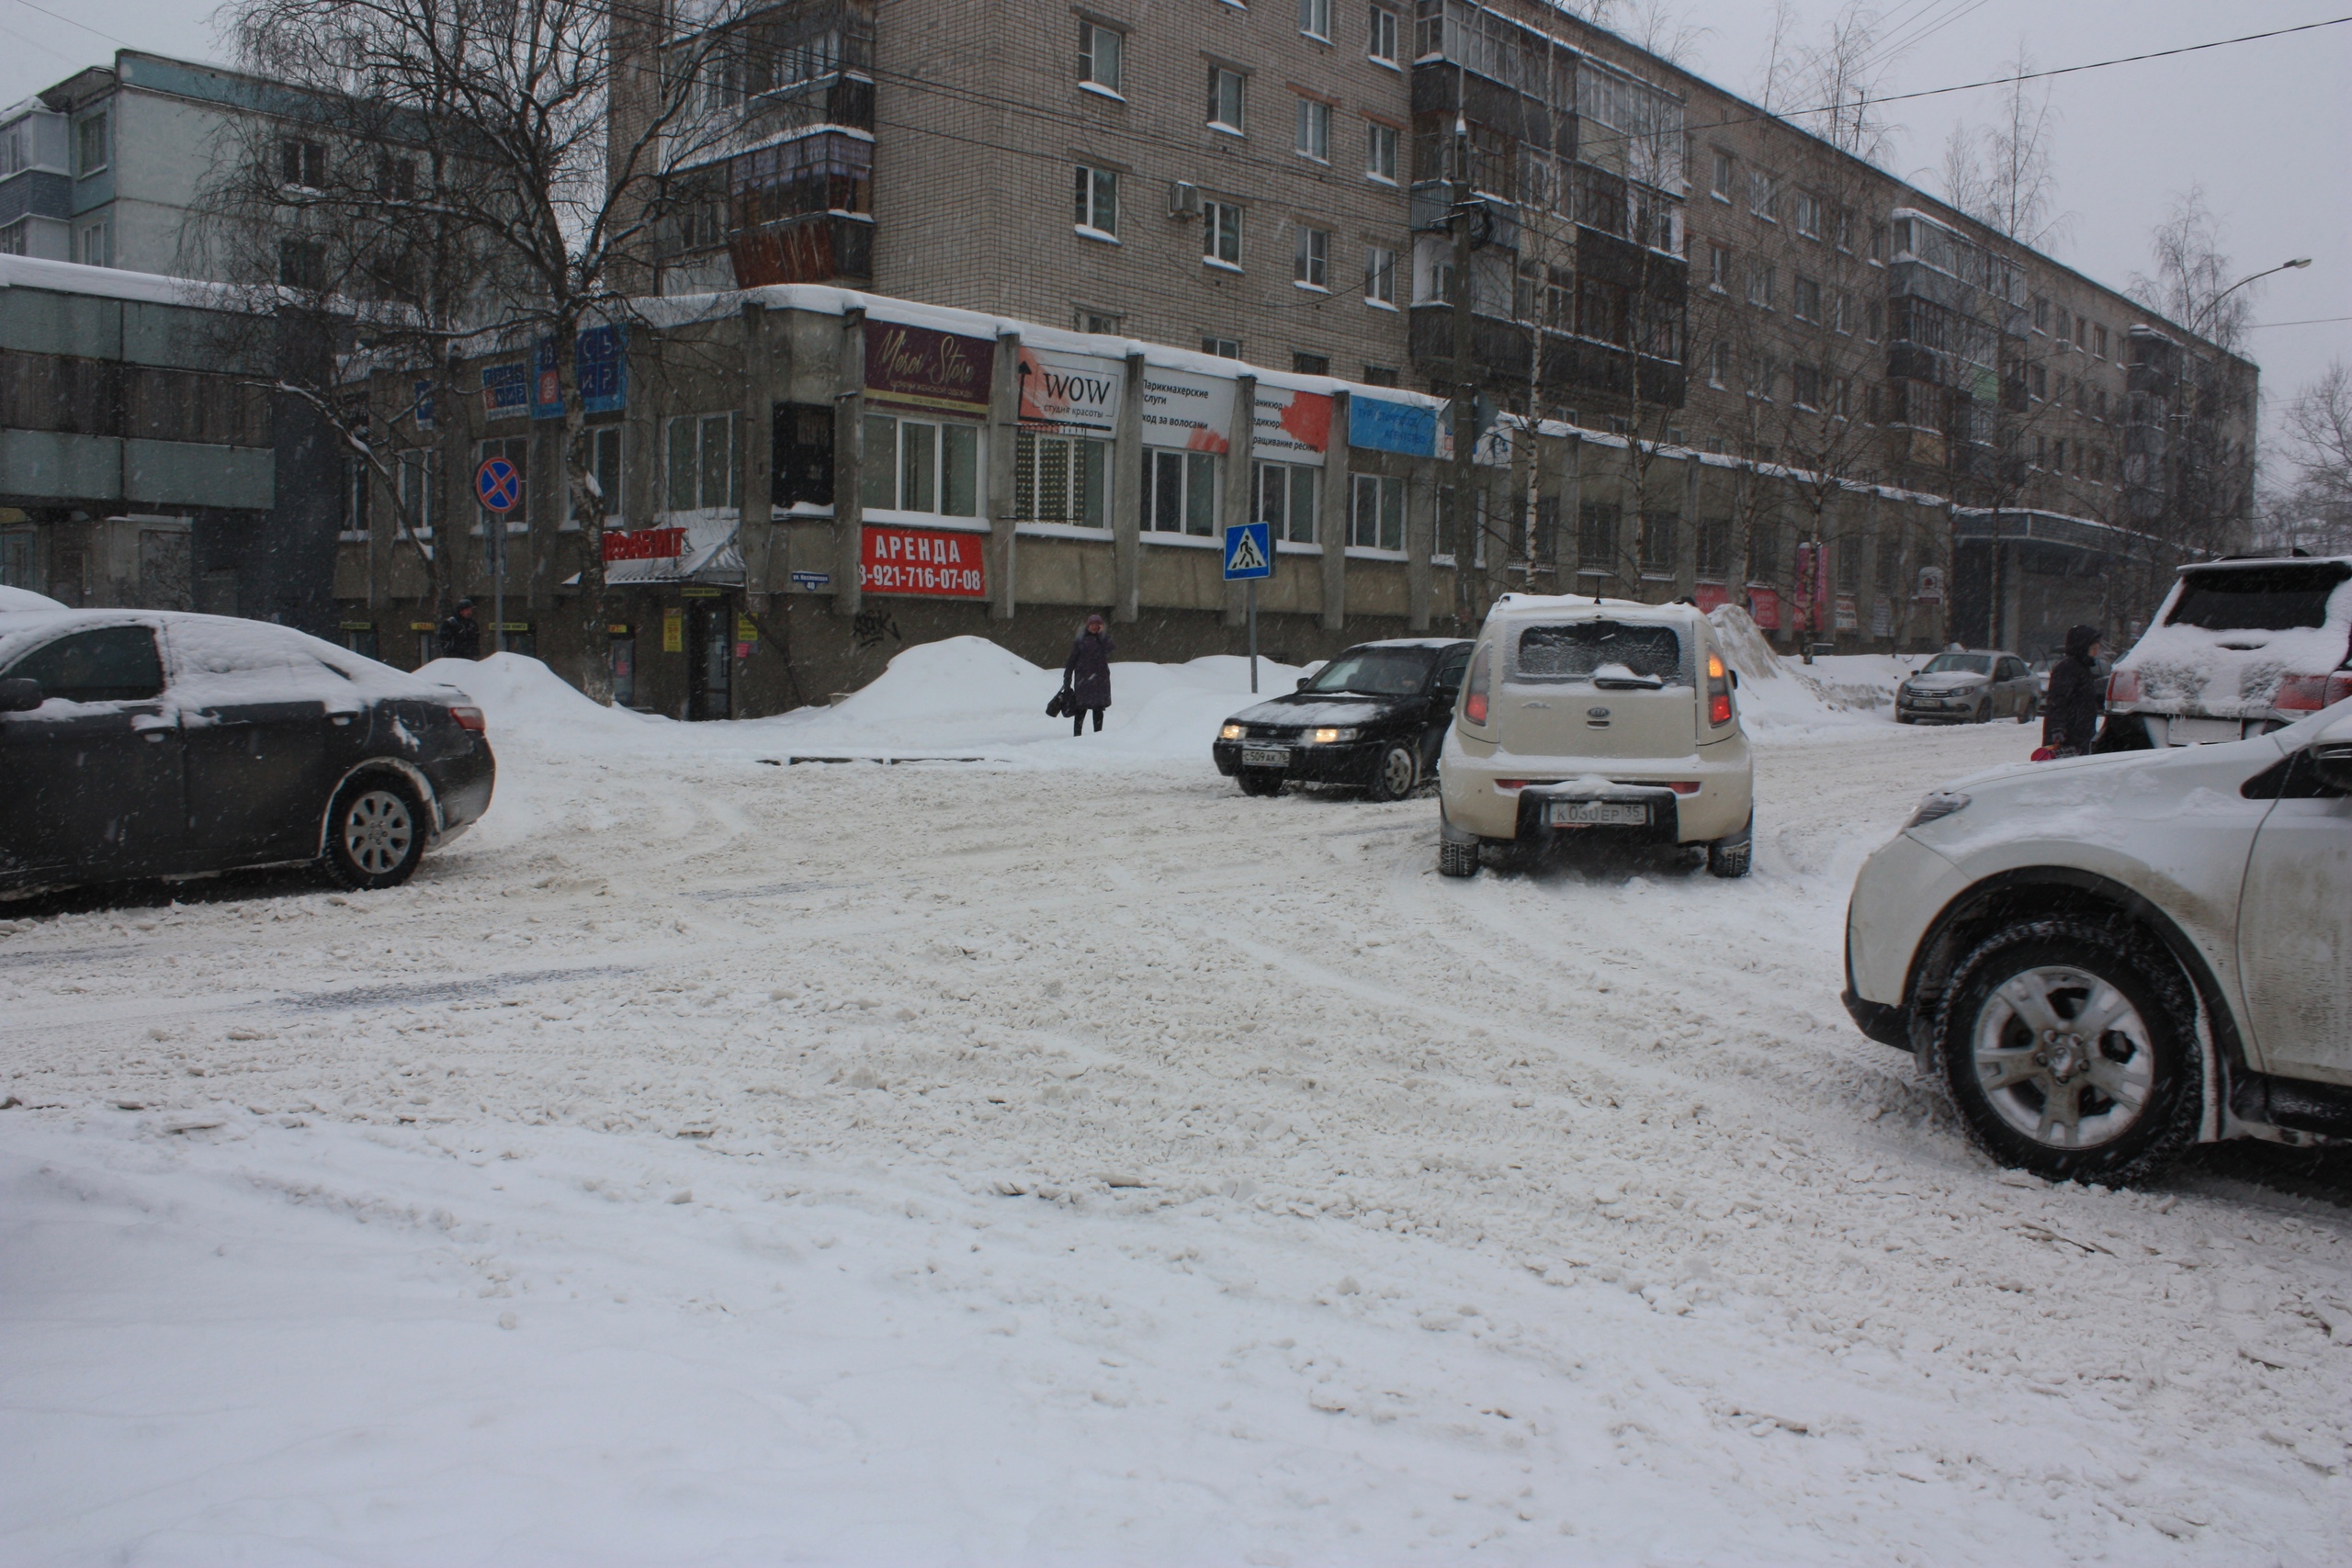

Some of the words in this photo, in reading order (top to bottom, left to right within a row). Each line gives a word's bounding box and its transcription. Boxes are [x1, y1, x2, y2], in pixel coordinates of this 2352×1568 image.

[1044, 373, 1111, 405] WOW
[1143, 394, 1167, 405] слуги
[1254, 399, 1283, 411] аникюр
[1044, 404, 1070, 415] студия
[1072, 407, 1103, 418] красоты
[1142, 413, 1157, 424] ход
[1159, 416, 1168, 424] за
[1169, 417, 1208, 430] волосами
[1251, 417, 1281, 429] едикюр
[1252, 436, 1293, 448] ращивание
[876, 535, 961, 565] АРЕНДА
[860, 564, 981, 591] 8-921-716-07-08
[807, 581, 816, 590] 40
[1624, 806, 1640, 818] 35
